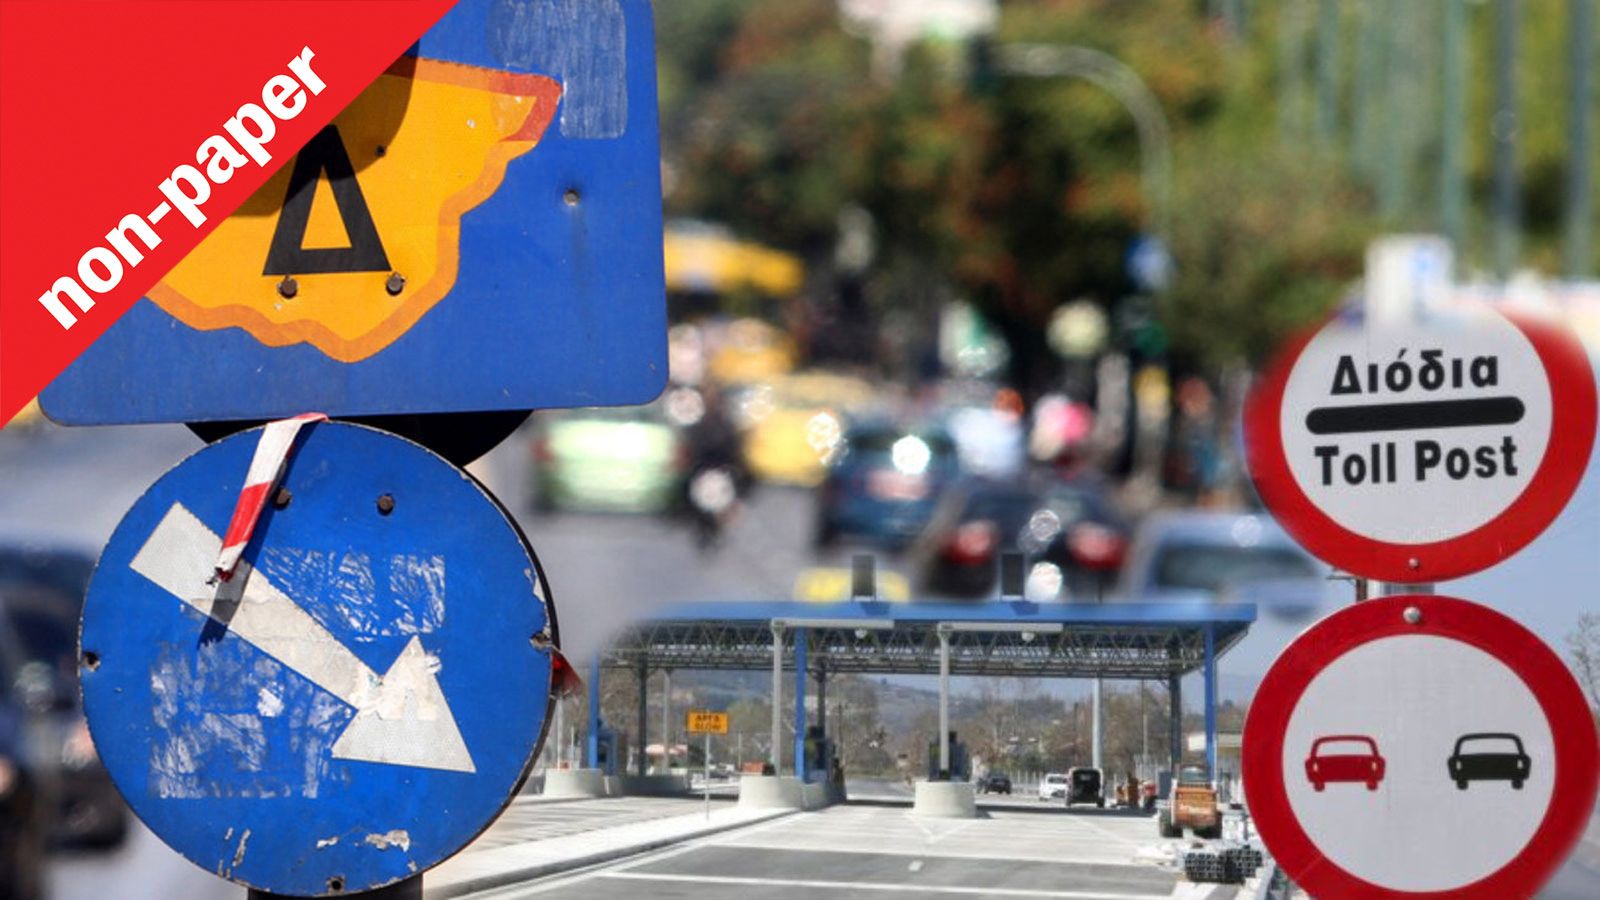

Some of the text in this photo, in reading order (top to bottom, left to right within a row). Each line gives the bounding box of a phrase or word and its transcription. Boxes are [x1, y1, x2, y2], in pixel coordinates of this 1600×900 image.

[1330, 348, 1498, 395] Διόδια
[1314, 436, 1518, 486] Toll Post
